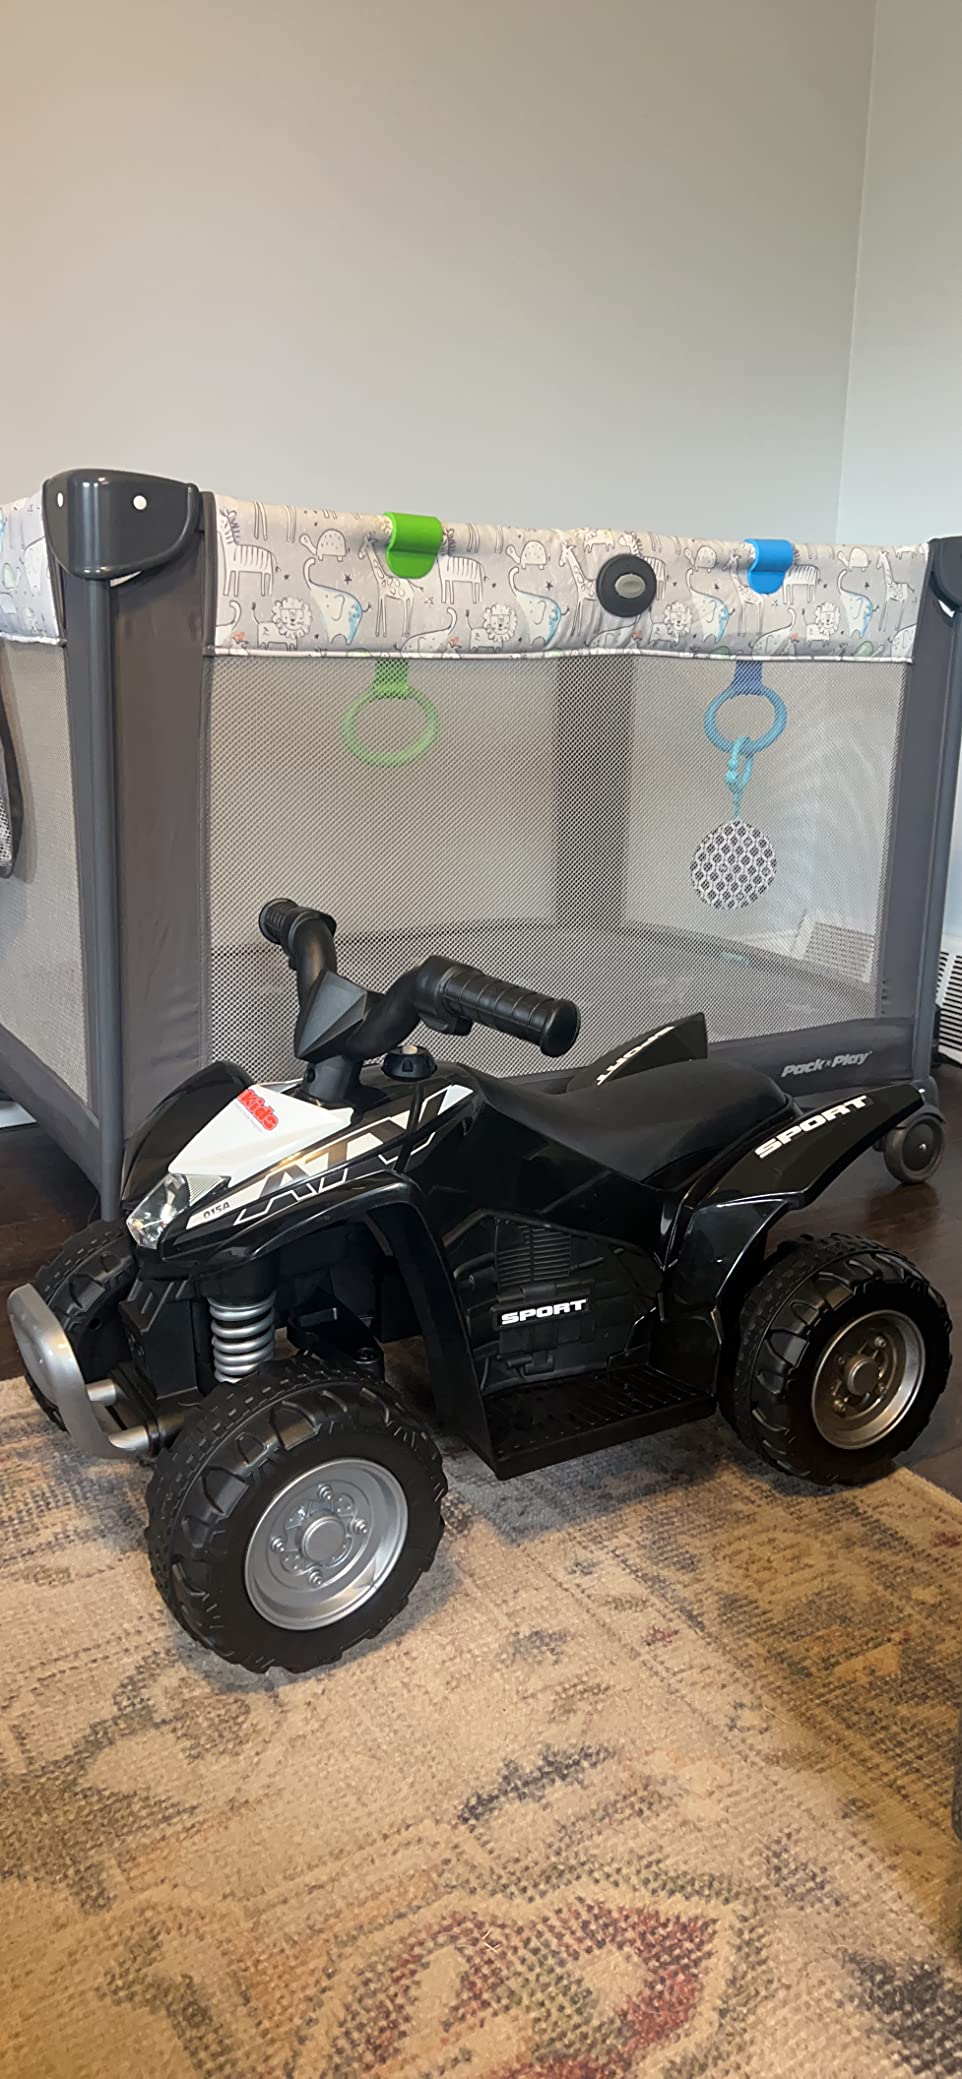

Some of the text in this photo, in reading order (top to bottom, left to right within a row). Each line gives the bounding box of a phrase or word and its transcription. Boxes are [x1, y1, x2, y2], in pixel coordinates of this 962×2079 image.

[780, 1058, 826, 1078] Pack
[831, 1052, 870, 1068] Play
[754, 1095, 869, 1159] SPORT
[234, 1084, 454, 1225] ATV
[501, 1298, 587, 1325] SPORT
